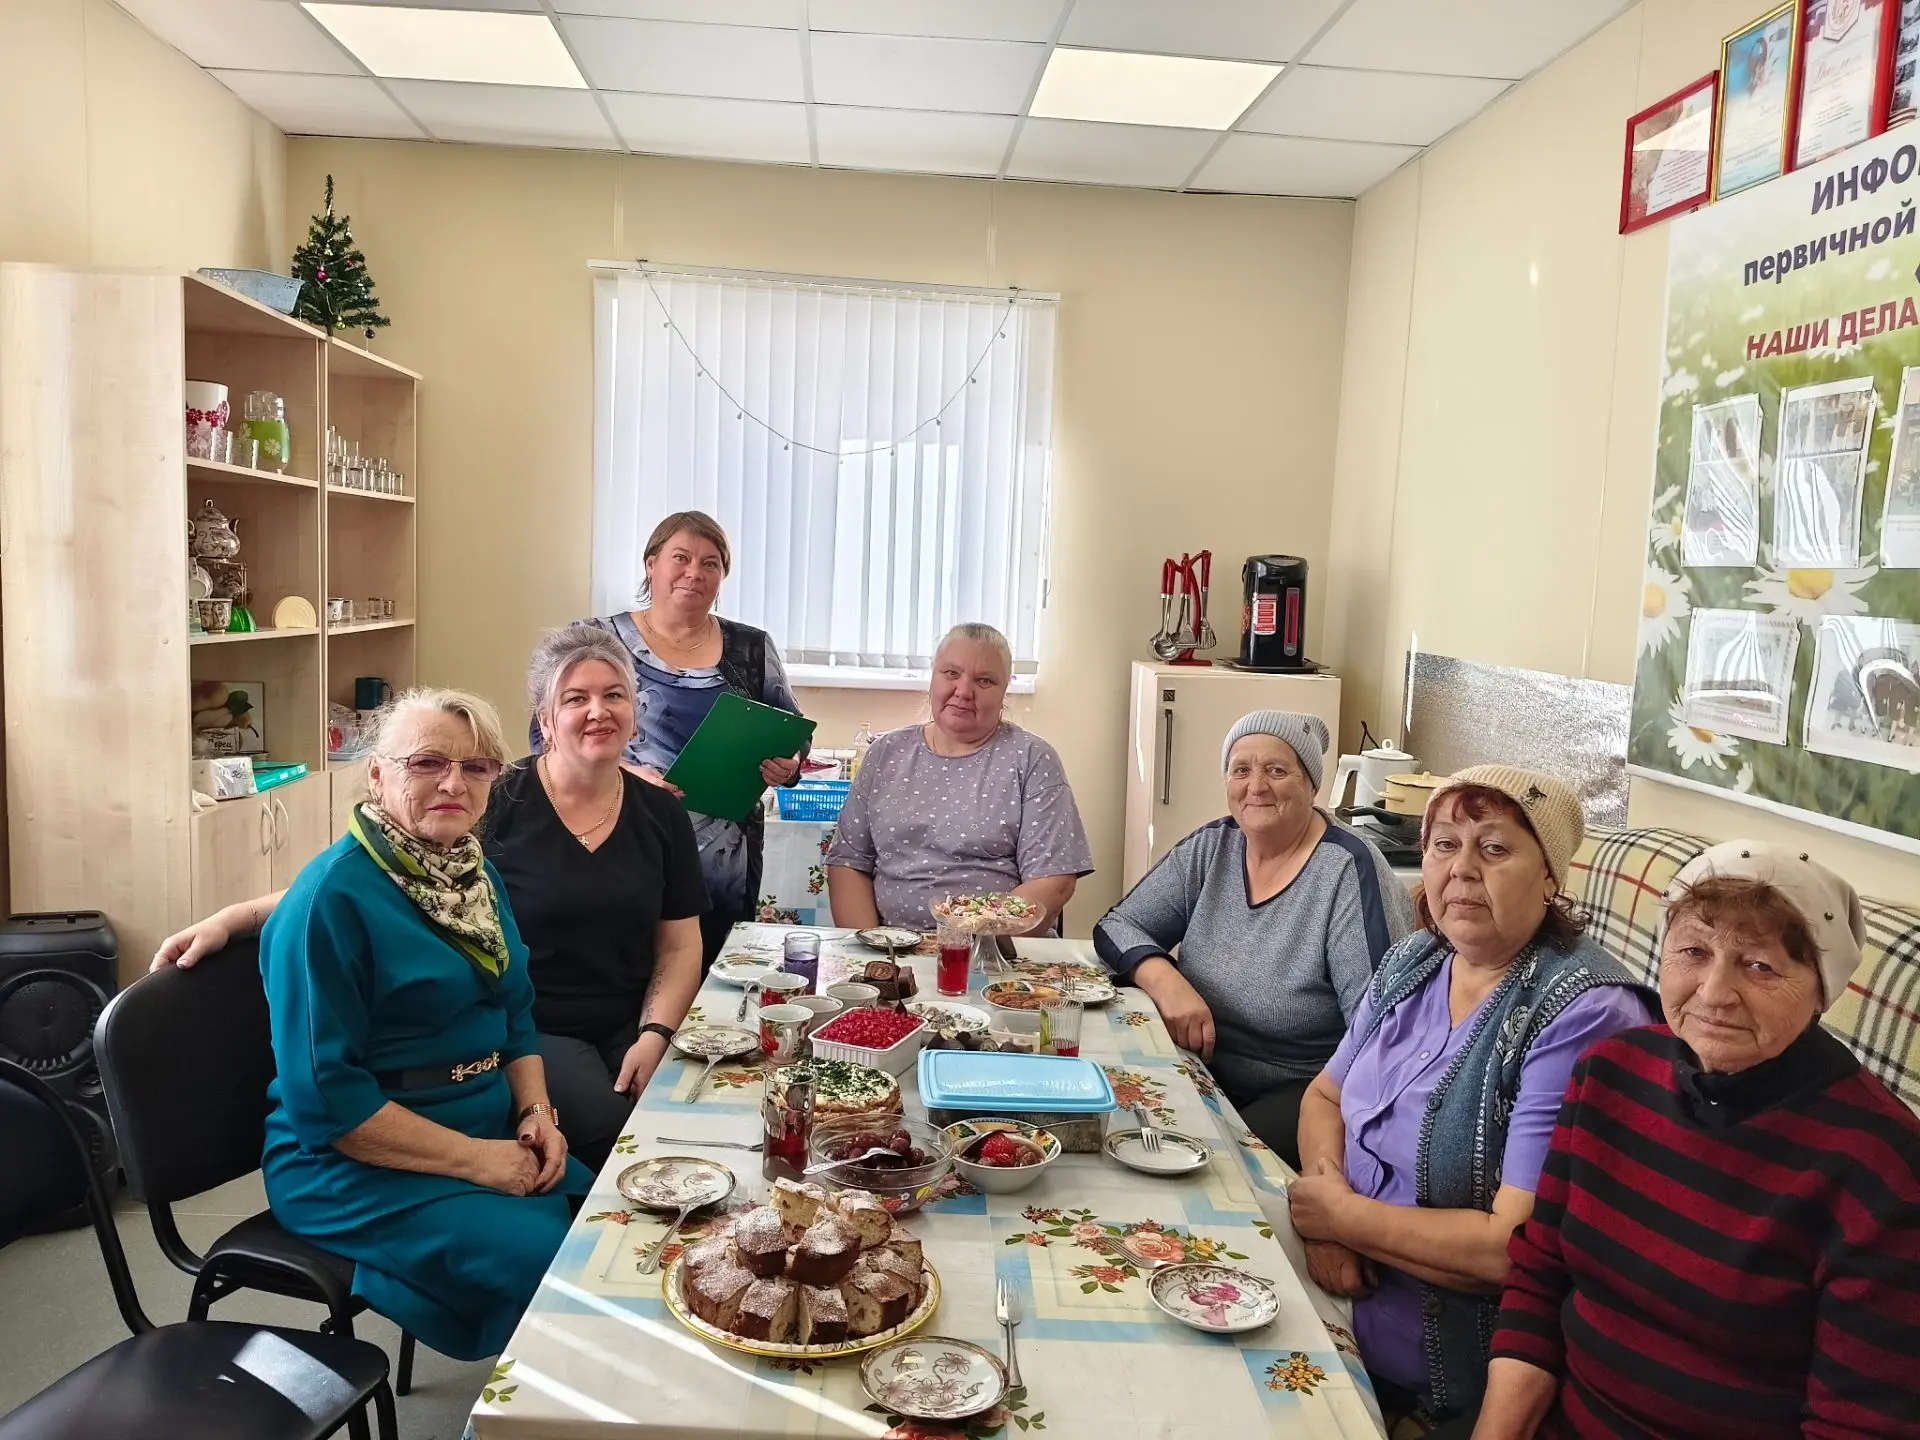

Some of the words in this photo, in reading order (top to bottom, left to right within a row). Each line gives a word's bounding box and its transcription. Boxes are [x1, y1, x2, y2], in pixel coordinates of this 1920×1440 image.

[1811, 144, 1920, 215] ИНФО
[1744, 198, 1916, 286] первичной
[1746, 319, 1829, 361] НАШИ
[1837, 296, 1919, 348] ДЕЛА
